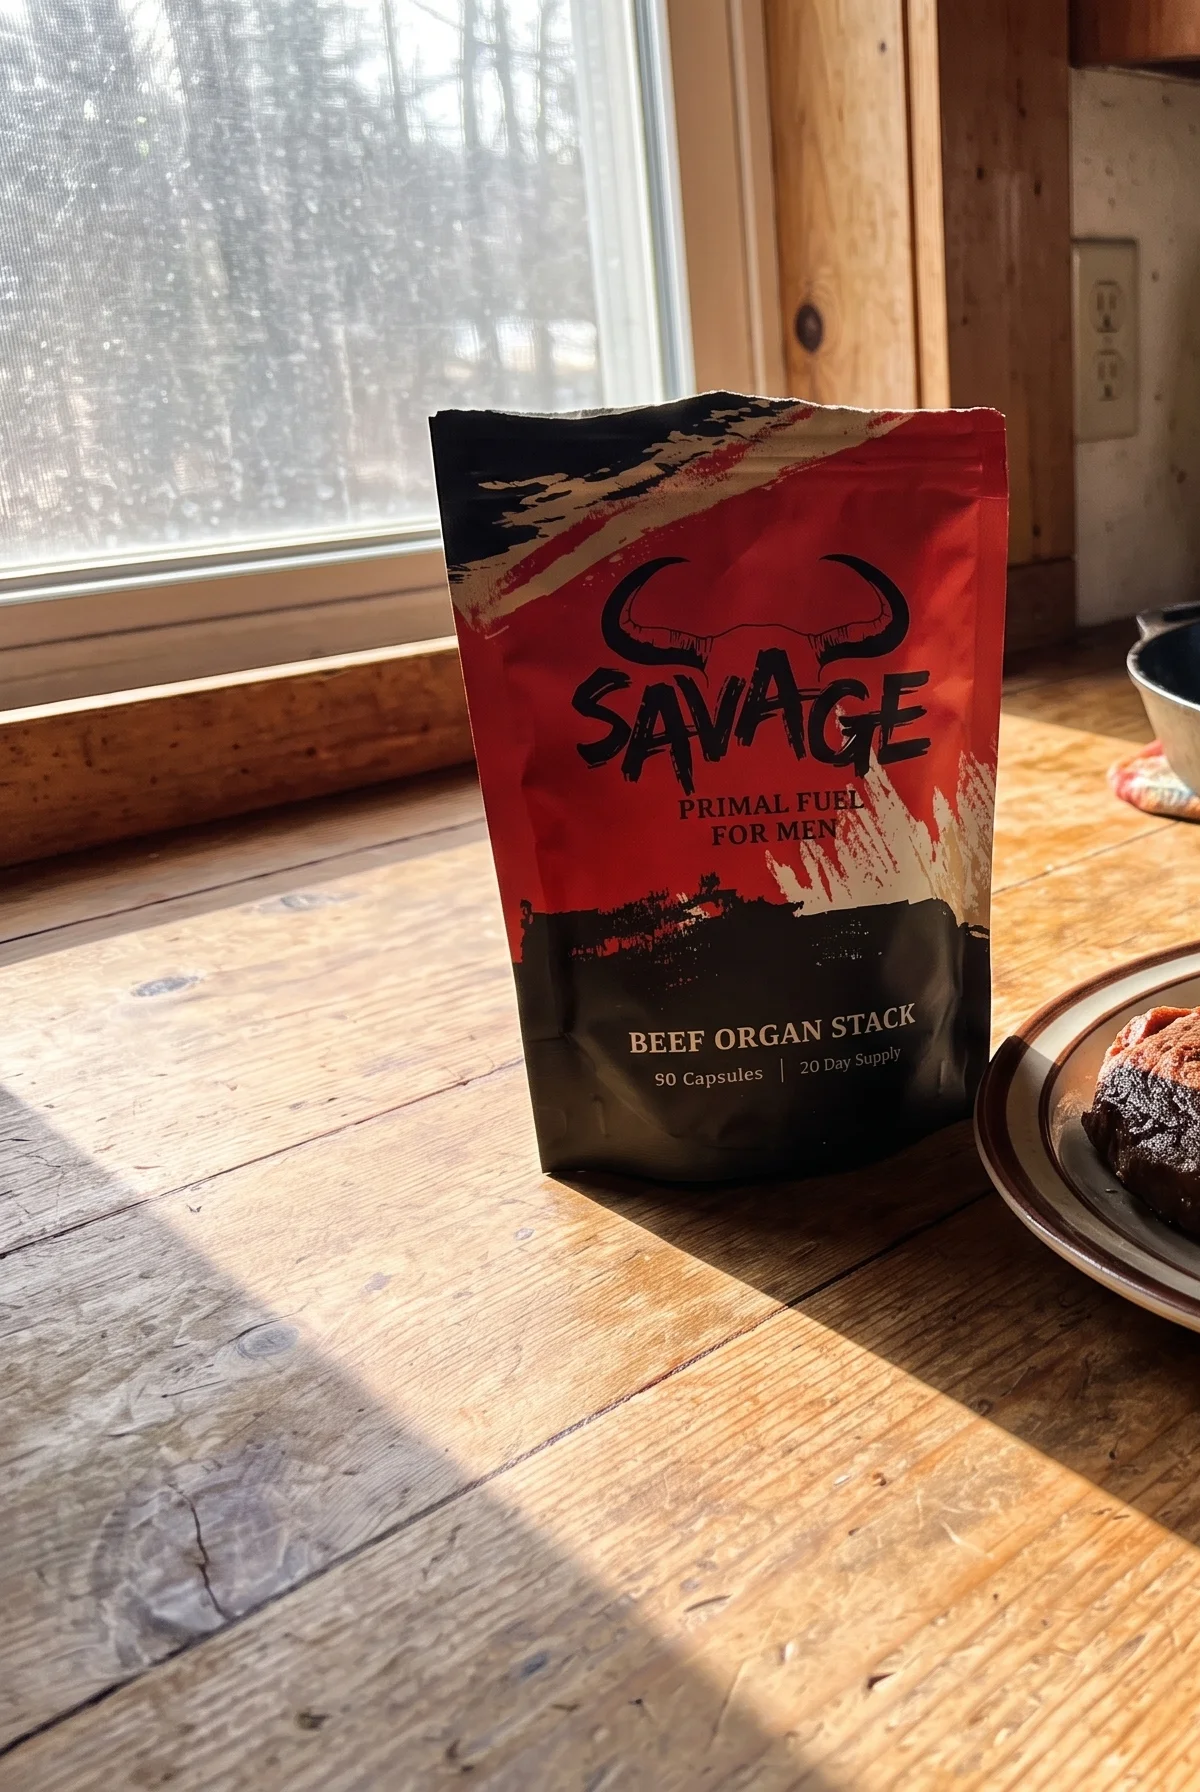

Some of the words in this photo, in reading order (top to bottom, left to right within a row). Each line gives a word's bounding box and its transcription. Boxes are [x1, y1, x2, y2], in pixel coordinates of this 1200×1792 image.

[571, 647, 932, 796] SAVAGE
[679, 796, 789, 820] PRIMAL
[797, 790, 865, 813] FUEL
[711, 823, 770, 847] FOR
[777, 818, 839, 842] MEN
[629, 1030, 705, 1054] BEEF
[714, 1019, 822, 1051] ORGAN
[831, 1003, 917, 1039] STACK
[683, 1067, 764, 1089] Capsules
[800, 1059, 820, 1075] 20
[824, 1057, 852, 1073] Day
[855, 1047, 902, 1066] Supply
